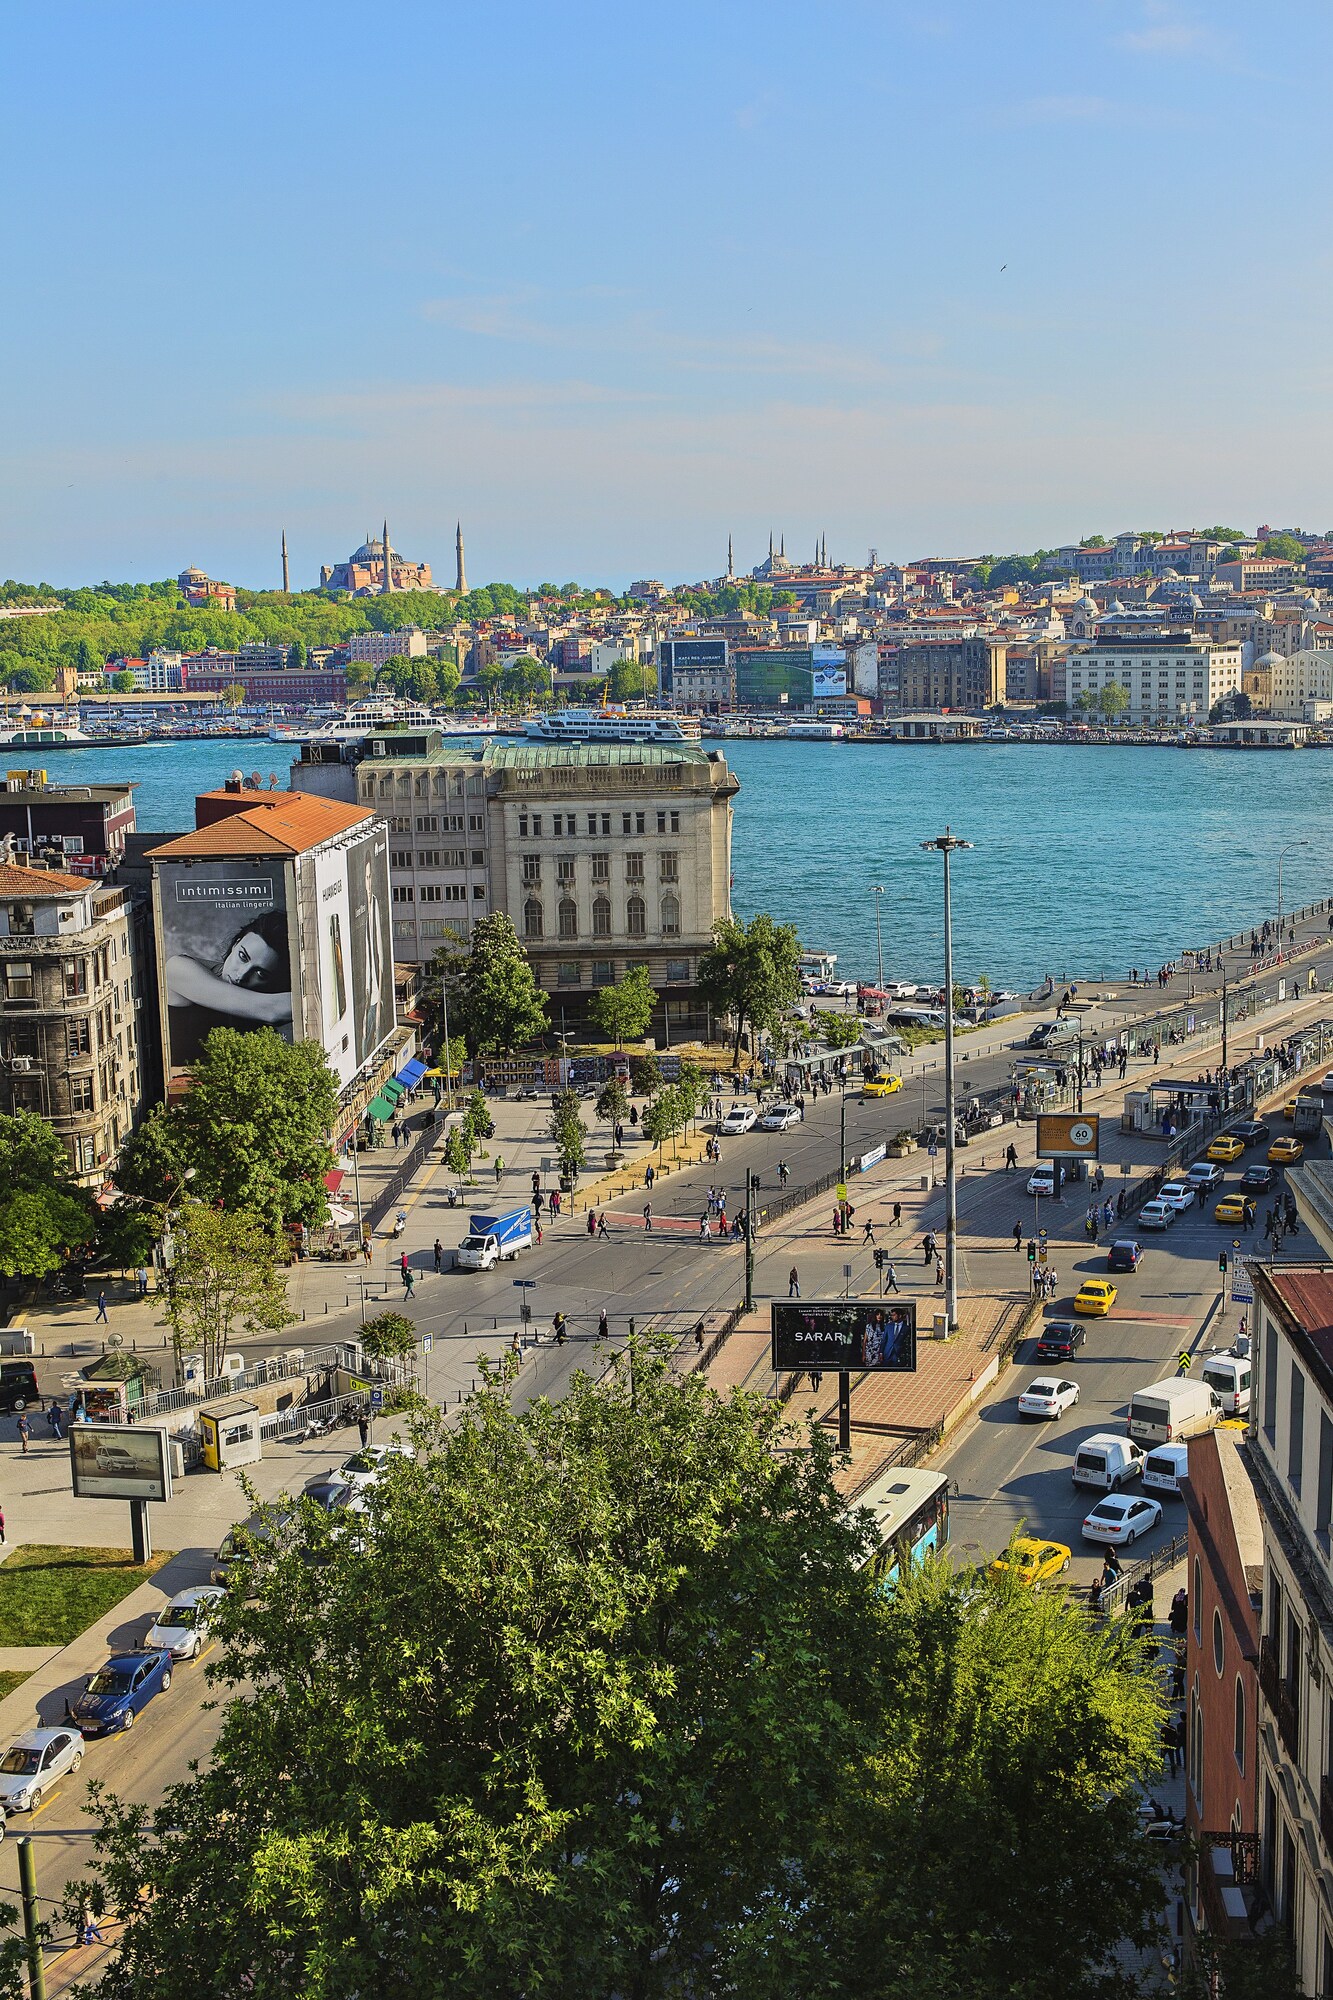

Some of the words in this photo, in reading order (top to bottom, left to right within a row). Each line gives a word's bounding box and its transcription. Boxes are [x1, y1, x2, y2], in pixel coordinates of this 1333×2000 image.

[182, 886, 267, 896] intimissimi
[243, 901, 274, 909] lingerie
[1075, 1130, 1088, 1138] 60
[795, 1332, 843, 1341] SARAR
